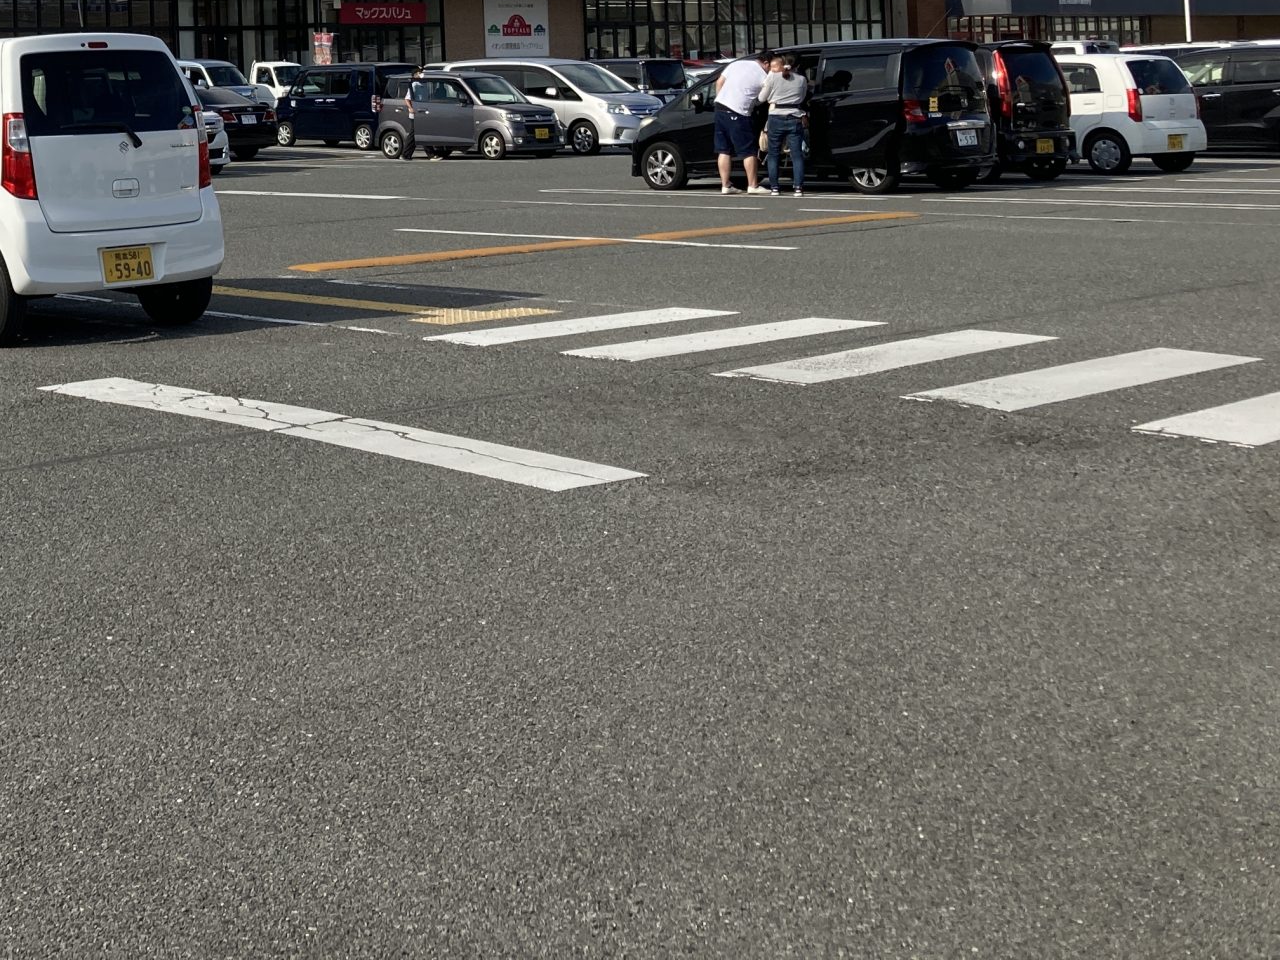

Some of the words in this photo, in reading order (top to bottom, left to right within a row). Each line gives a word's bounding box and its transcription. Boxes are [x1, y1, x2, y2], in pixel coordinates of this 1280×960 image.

[355, 7, 412, 19] マックスバリュ
[114, 260, 152, 280] 59-40
